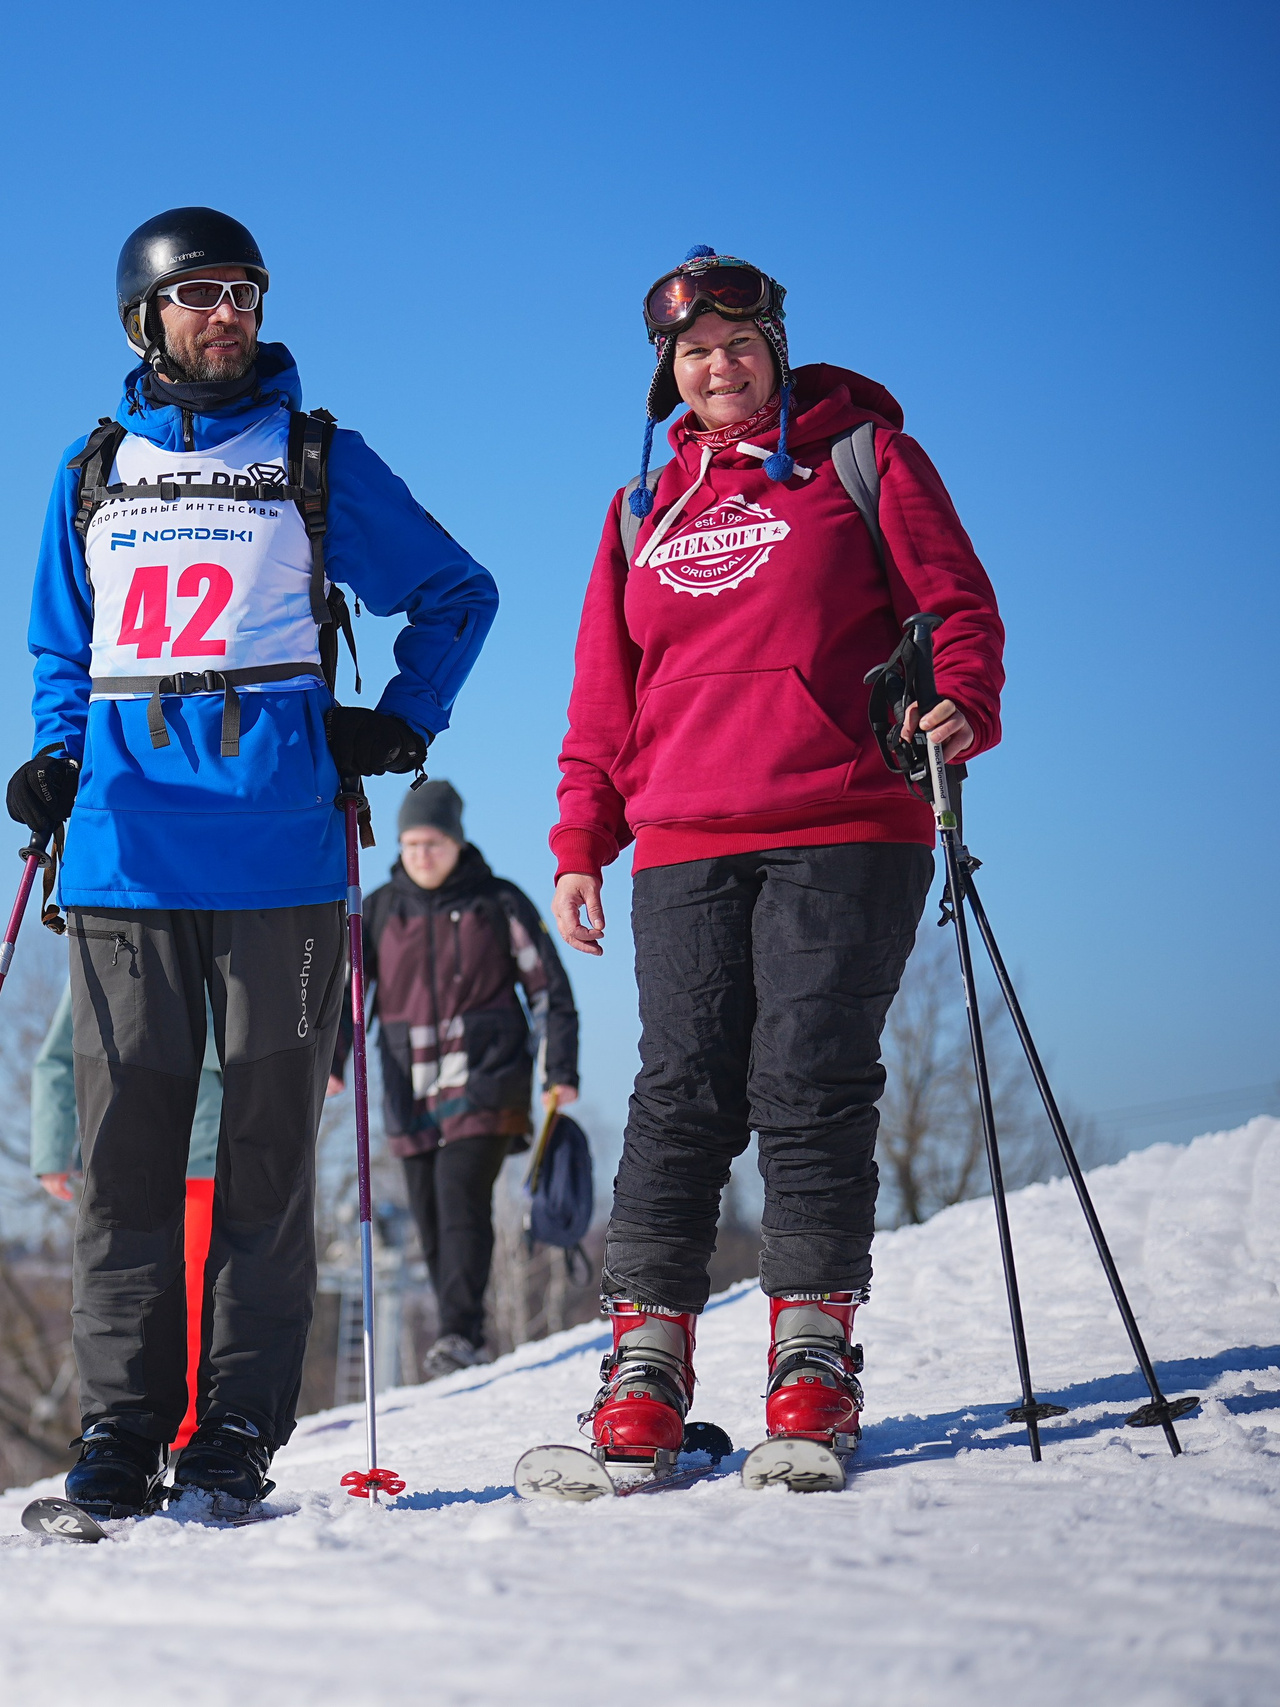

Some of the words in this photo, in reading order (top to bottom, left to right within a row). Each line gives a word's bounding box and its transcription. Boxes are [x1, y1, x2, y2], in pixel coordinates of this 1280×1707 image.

[91, 503, 179, 528] СПОРТИВНЫЕ
[186, 502, 279, 518] ИНТЕНСИВЫ
[694, 517, 717, 528] est.
[142, 528, 253, 543] NORDSKI
[680, 554, 747, 578] ORIGINAL
[116, 562, 234, 660] 42
[297, 938, 315, 1038] Quechua
[40, 1515, 83, 1534] K2
